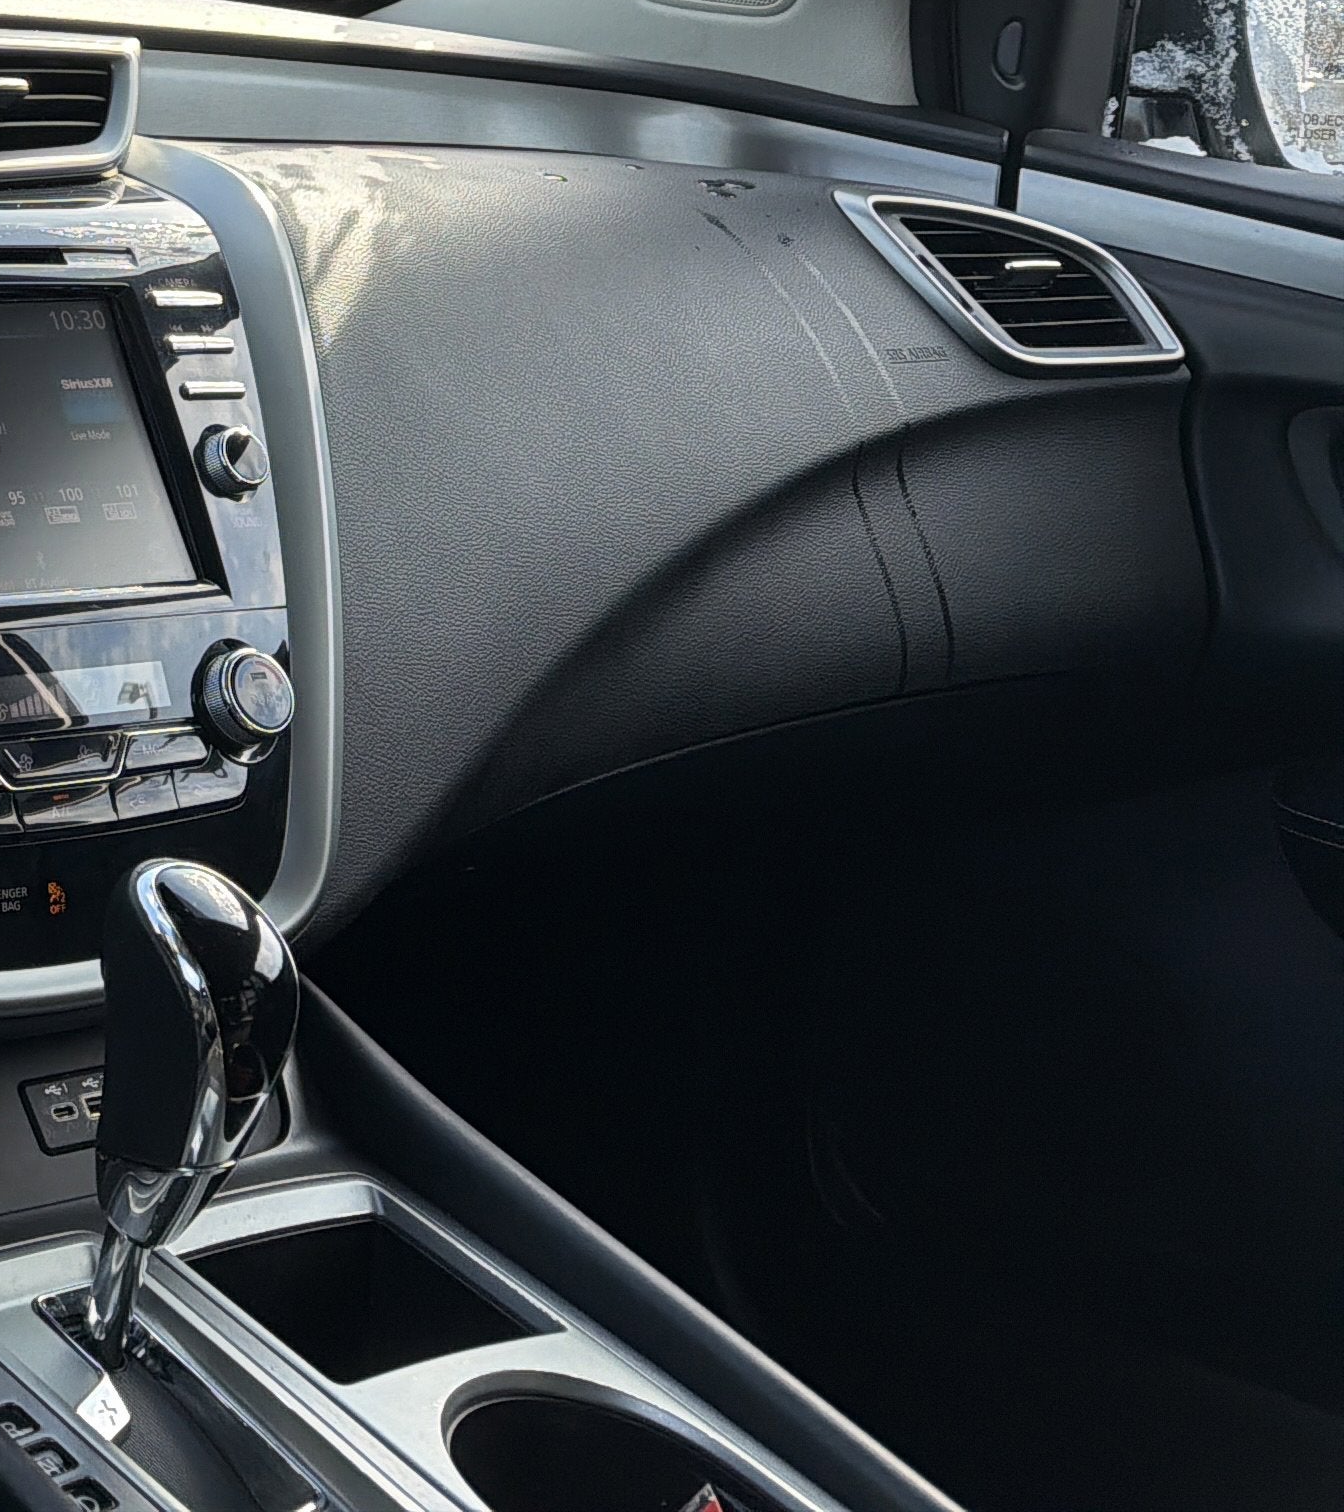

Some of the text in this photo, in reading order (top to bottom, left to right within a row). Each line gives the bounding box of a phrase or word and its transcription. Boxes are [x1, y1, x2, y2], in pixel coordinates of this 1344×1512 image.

[49, 310, 107, 330] 10:30
[59, 488, 84, 502] 100
[116, 484, 139, 498] 101
[8, 491, 26, 506] 95
[2, 901, 21, 913] BAG
[49, 904, 67, 915] OFF
